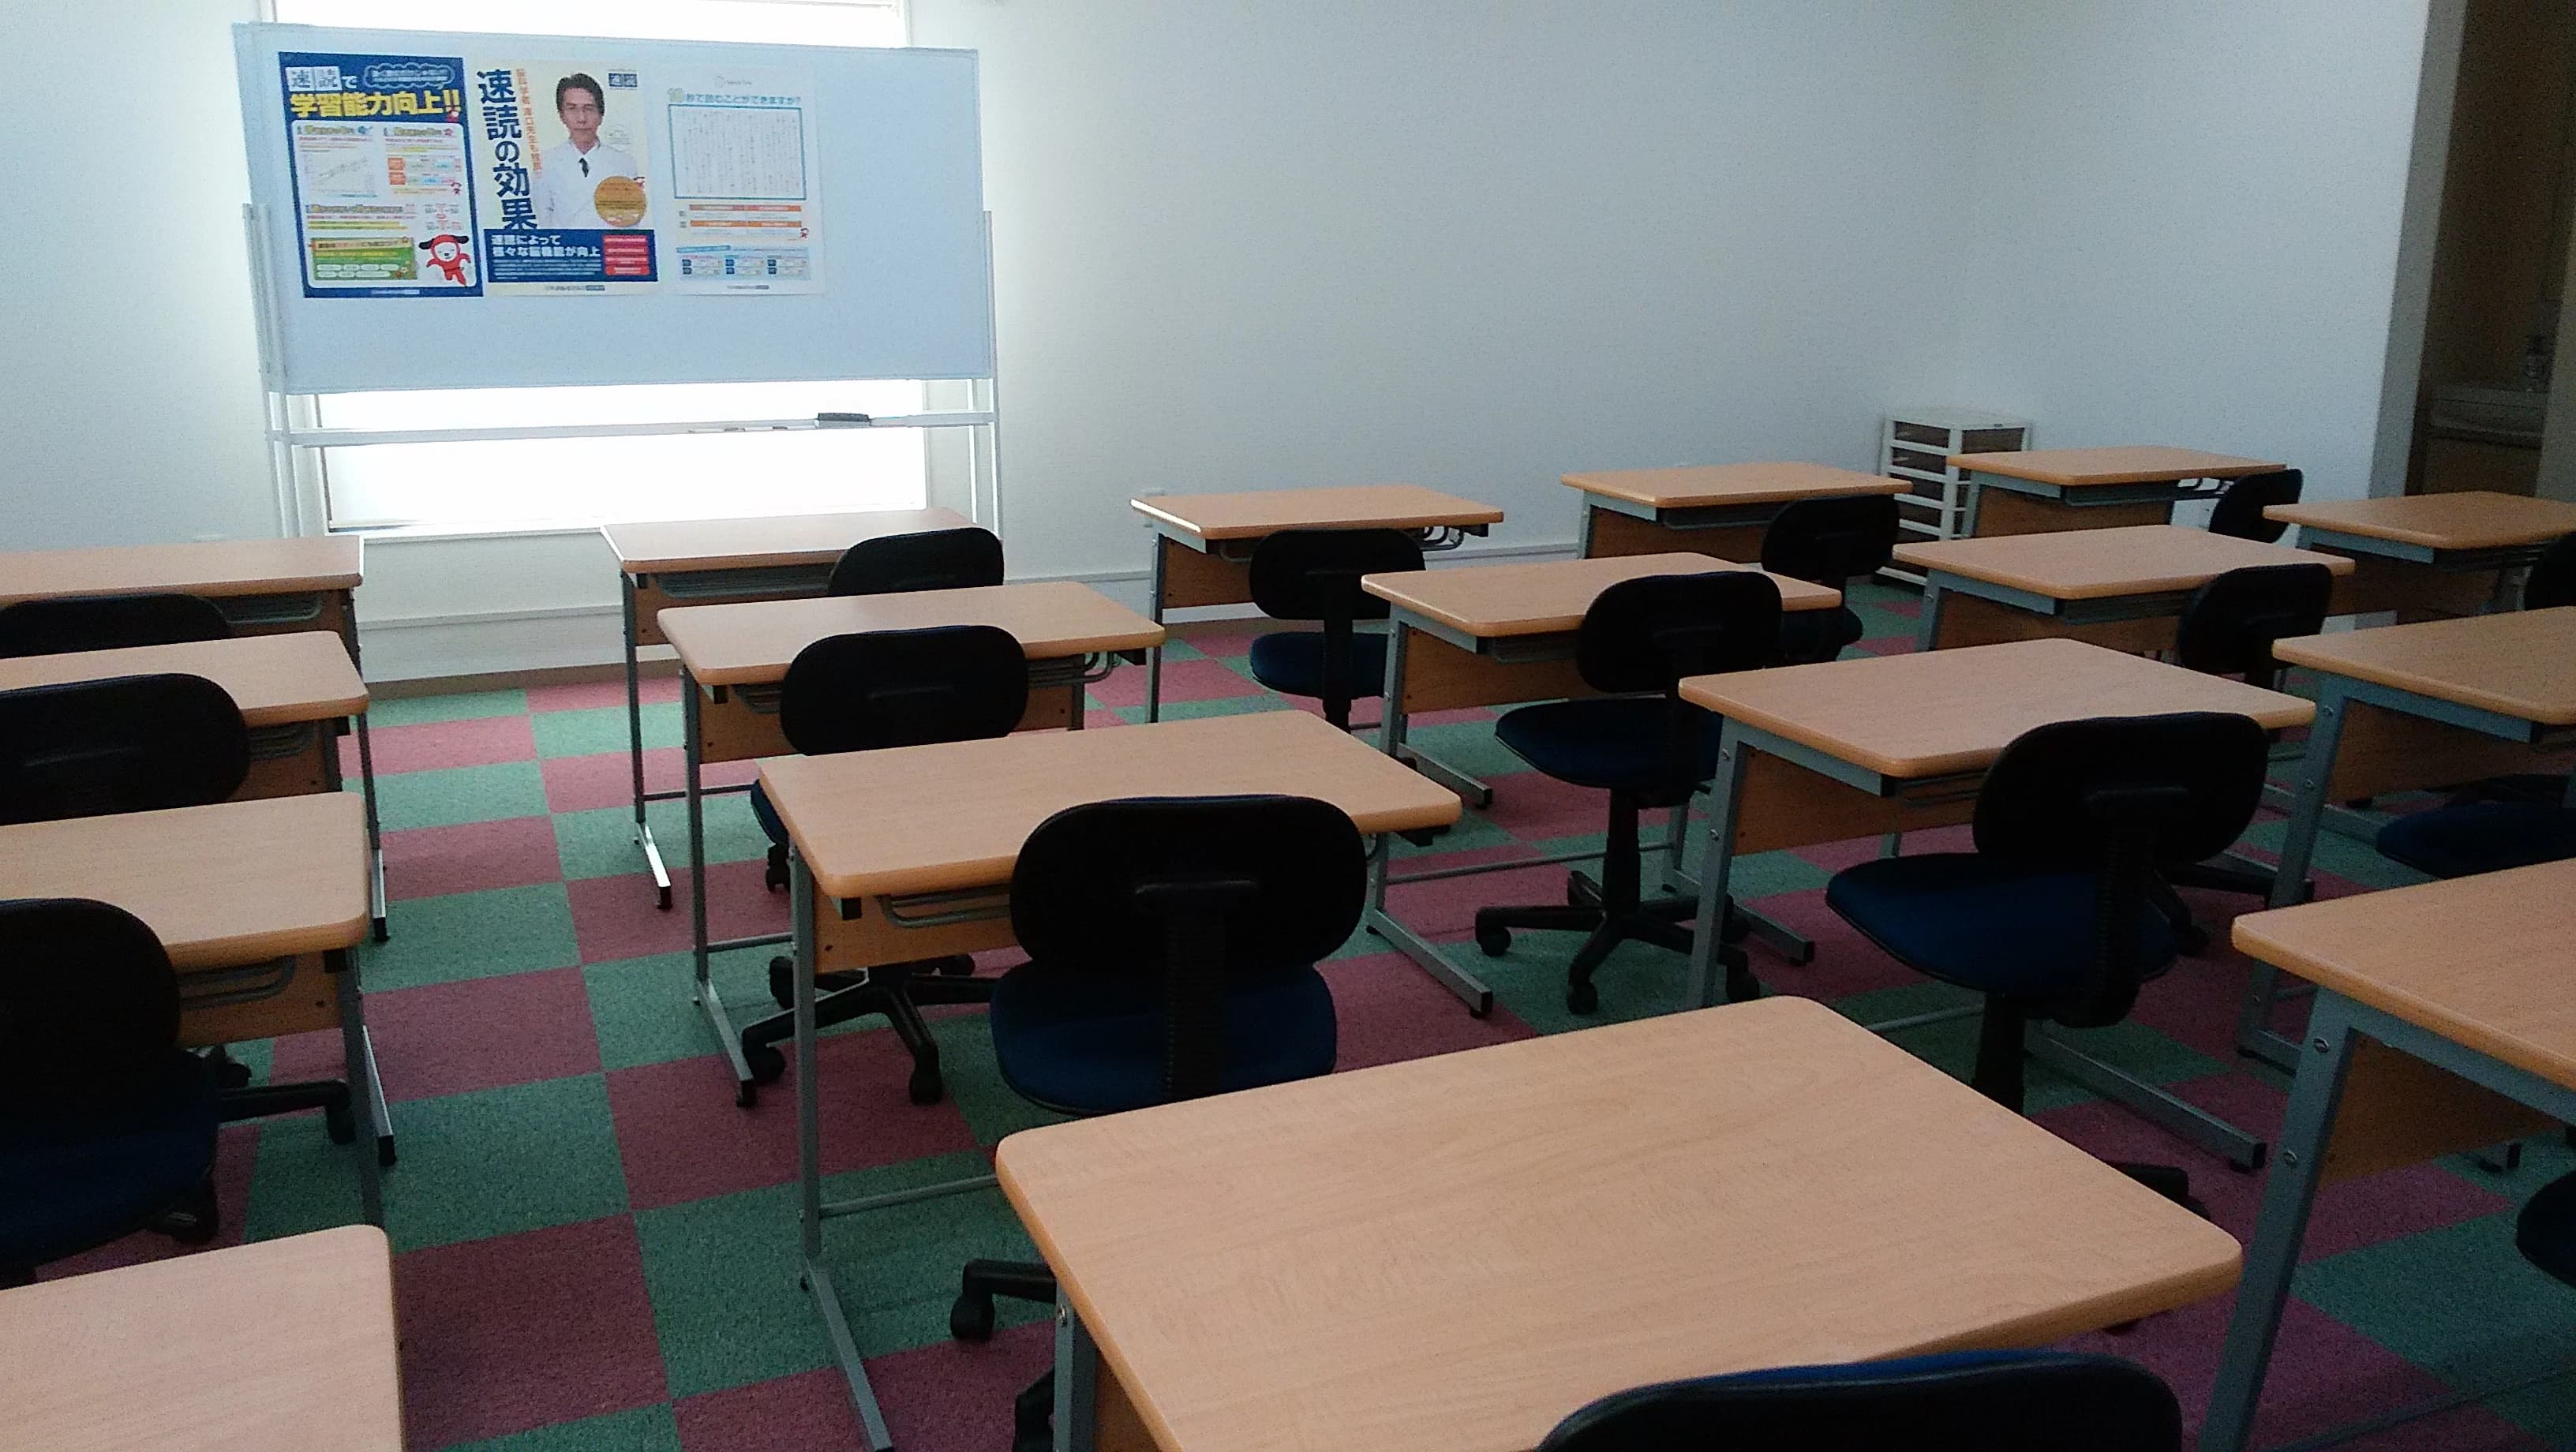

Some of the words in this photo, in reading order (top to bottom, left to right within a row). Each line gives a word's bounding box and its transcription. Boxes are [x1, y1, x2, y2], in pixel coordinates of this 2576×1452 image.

[290, 89, 461, 118] 学習能力向上!!
[477, 69, 537, 229] 速読の効果
